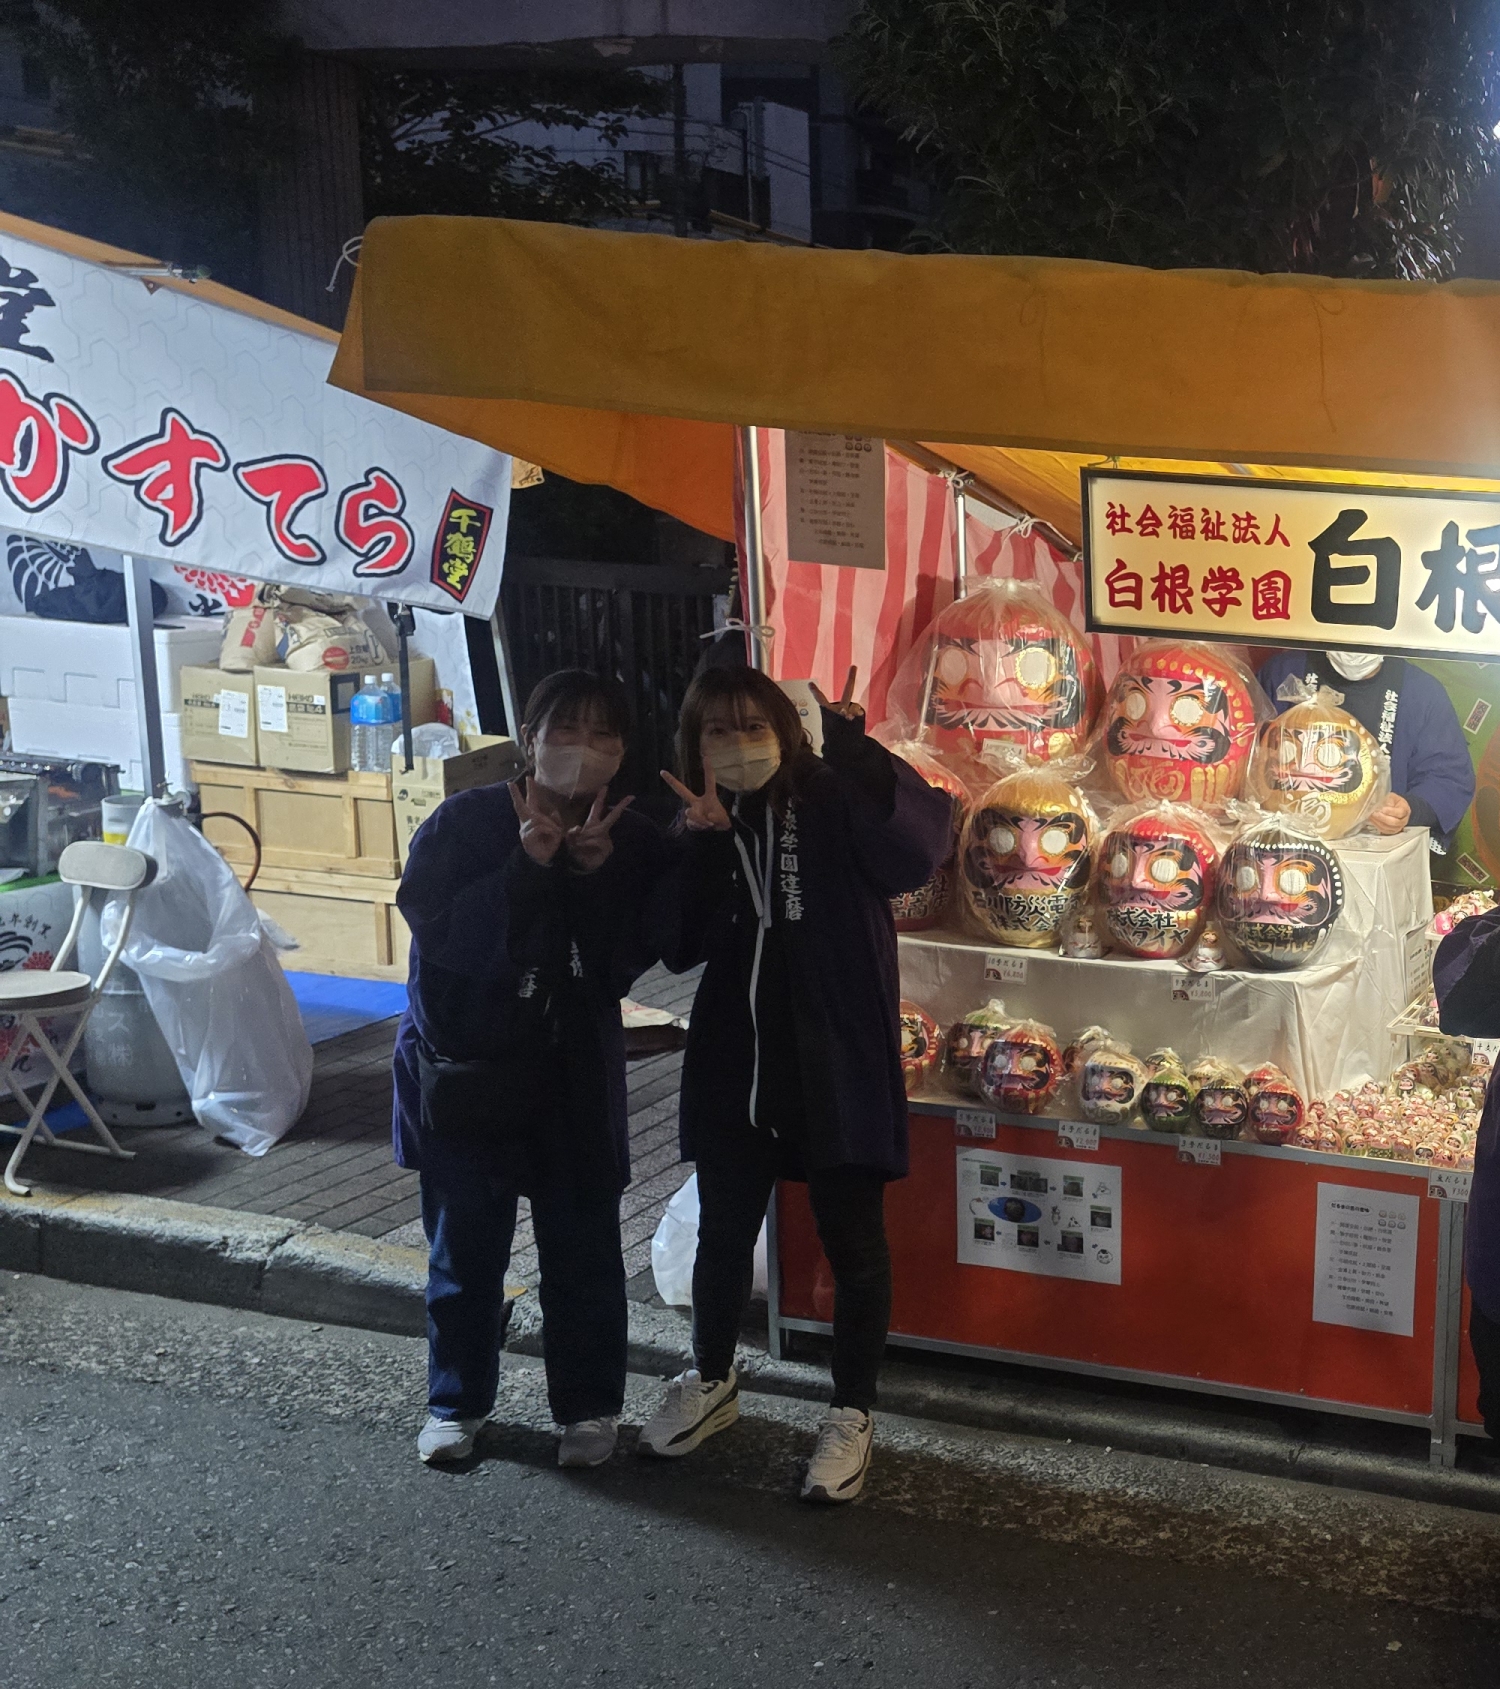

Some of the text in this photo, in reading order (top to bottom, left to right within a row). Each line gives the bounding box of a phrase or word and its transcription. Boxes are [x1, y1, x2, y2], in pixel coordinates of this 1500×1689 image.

[1104, 501, 1293, 549] 社会福祉法人
[1104, 558, 1294, 623] 白根学園
[780, 797, 805, 921] 根学園達磨
[1107, 907, 1177, 930] 株式会社
